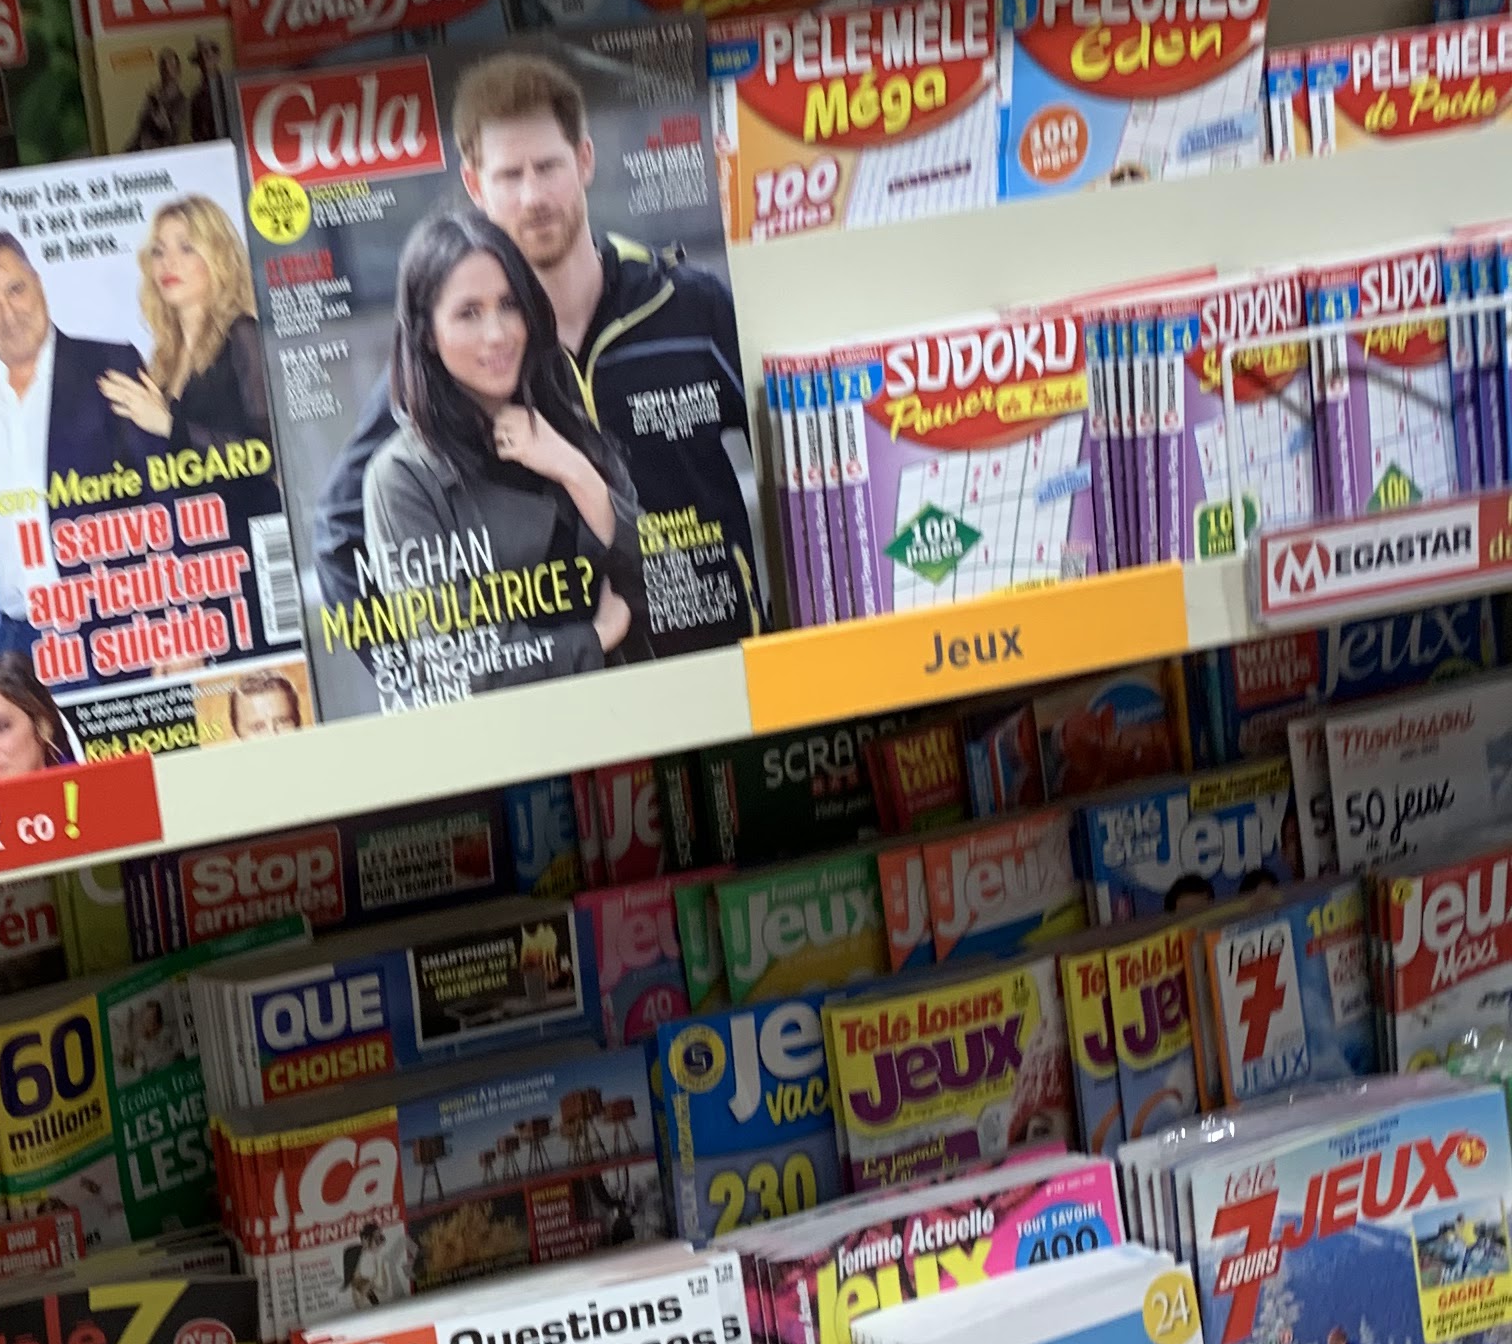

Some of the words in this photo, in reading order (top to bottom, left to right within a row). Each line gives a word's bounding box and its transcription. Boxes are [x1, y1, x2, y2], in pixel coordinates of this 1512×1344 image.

[253, 74, 427, 175] Gala
[754, 157, 839, 205] 100
[887, 317, 1077, 397] SUDOKU
[888, 394, 996, 441] Power
[148, 439, 272, 492] BIGARD
[51, 505, 173, 564] sauve
[354, 525, 494, 599] MEGHAN
[911, 518, 957, 548] 100
[1274, 527, 1474, 594] MEGASTAR
[27, 546, 248, 629] agriculteur
[320, 562, 574, 655] MANIPULATRICE
[34, 636, 87, 687] du
[92, 604, 226, 681] suicide
[924, 626, 1024, 674] Jeux
[1335, 703, 1475, 754] Montessori
[191, 841, 337, 906] Stop
[734, 884, 878, 982] Jeux
[262, 971, 385, 1051] QUE
[267, 1042, 388, 1095] CHOISIR
[8, 1099, 103, 1152] millions
[710, 1155, 819, 1236] 230
[1281, 1129, 1472, 1249] JEUX
[836, 1232, 904, 1281] Femme
[907, 1208, 996, 1256] Actuelle
[1218, 1244, 1279, 1294] JOURS
[1438, 1277, 1496, 1312] GAGNEZ
